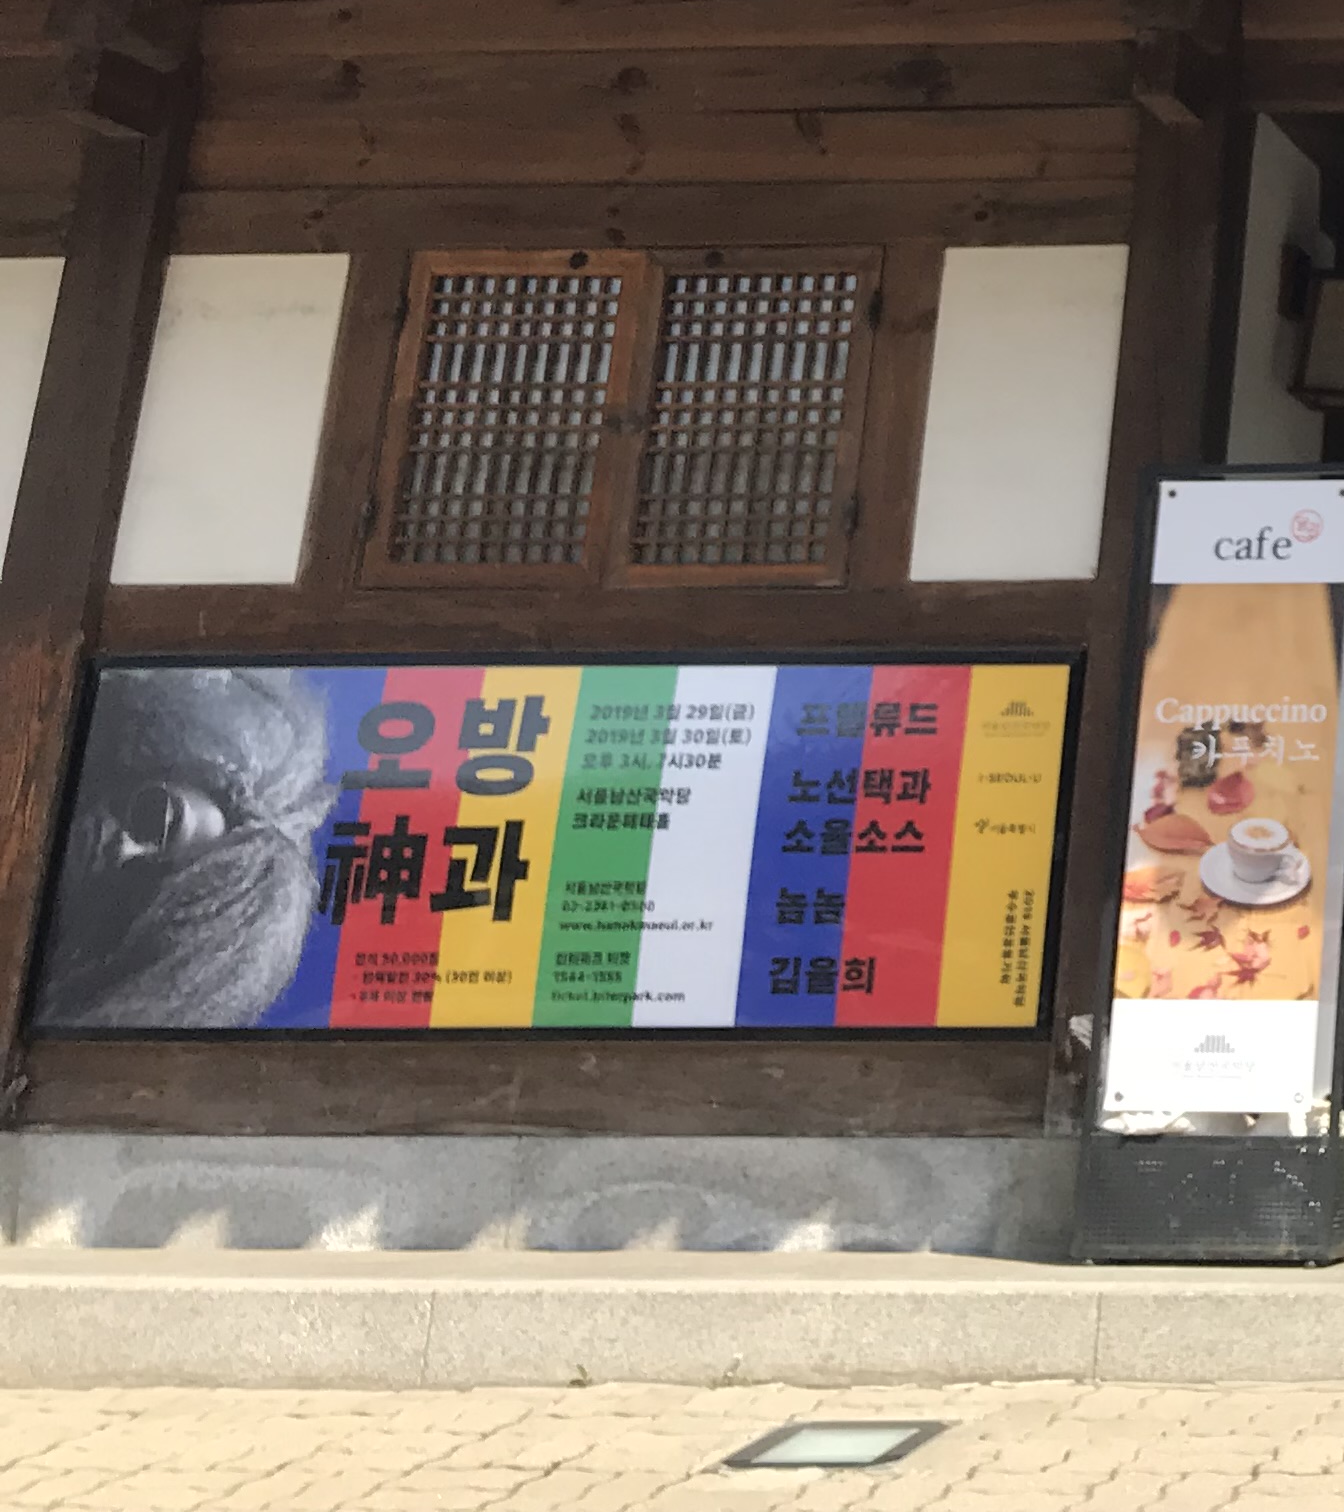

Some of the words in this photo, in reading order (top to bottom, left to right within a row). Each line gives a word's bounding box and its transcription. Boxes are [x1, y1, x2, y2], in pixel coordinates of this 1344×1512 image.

[1214, 525, 1293, 560] cafe
[590, 703, 649, 721] 2019년
[653, 703, 681, 721] 3월
[1154, 696, 1328, 731] Cappuccino
[340, 695, 551, 797] 오방
[584, 727, 645, 745] 2019년
[650, 728, 677, 745] 3월
[681, 728, 752, 746] 30일(토)
[1191, 734, 1320, 768] 카푸치노
[581, 752, 613, 770] 오후
[576, 787, 692, 806] 서울남산국악당
[788, 768, 931, 804] 노선택과
[781, 819, 925, 855] 소울소스
[318, 814, 531, 926] 神과
